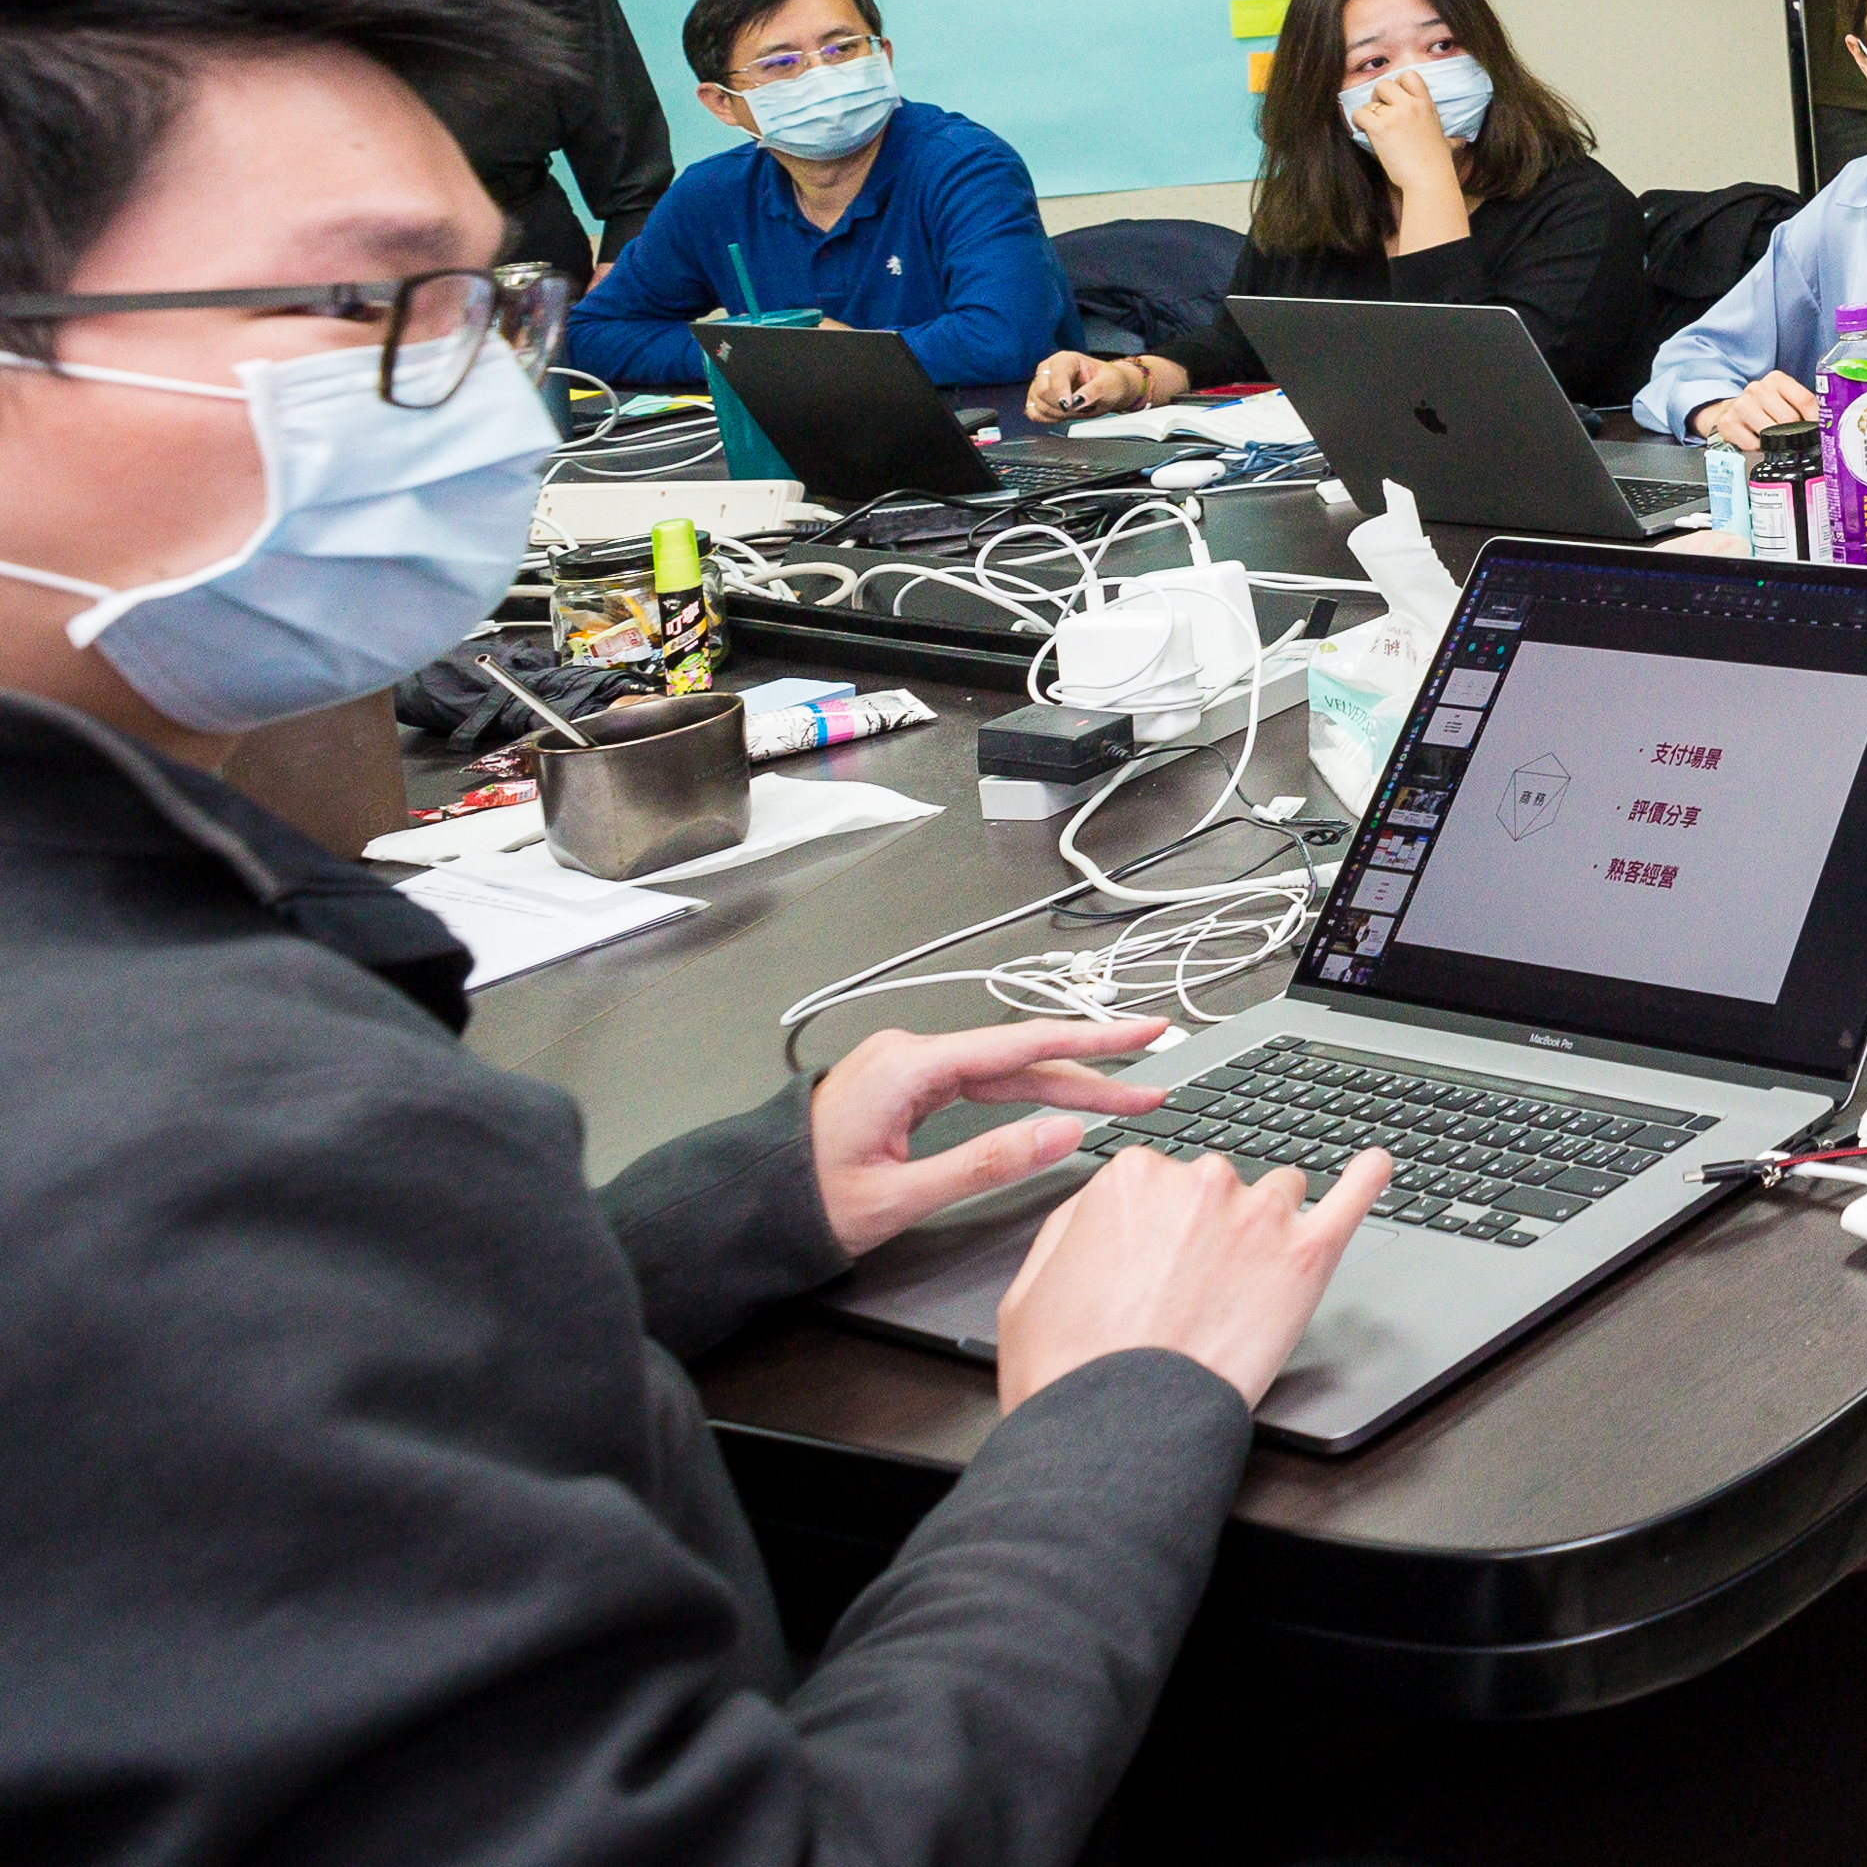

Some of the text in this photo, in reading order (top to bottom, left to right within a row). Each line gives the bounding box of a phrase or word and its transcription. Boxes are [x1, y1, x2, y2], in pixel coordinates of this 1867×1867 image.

[1650, 741, 1723, 771] 支付場景
[1627, 798, 1702, 829] 評價分享
[1604, 857, 1680, 890] 熟客經營
[1529, 1033, 1574, 1050] MacBook Pro
